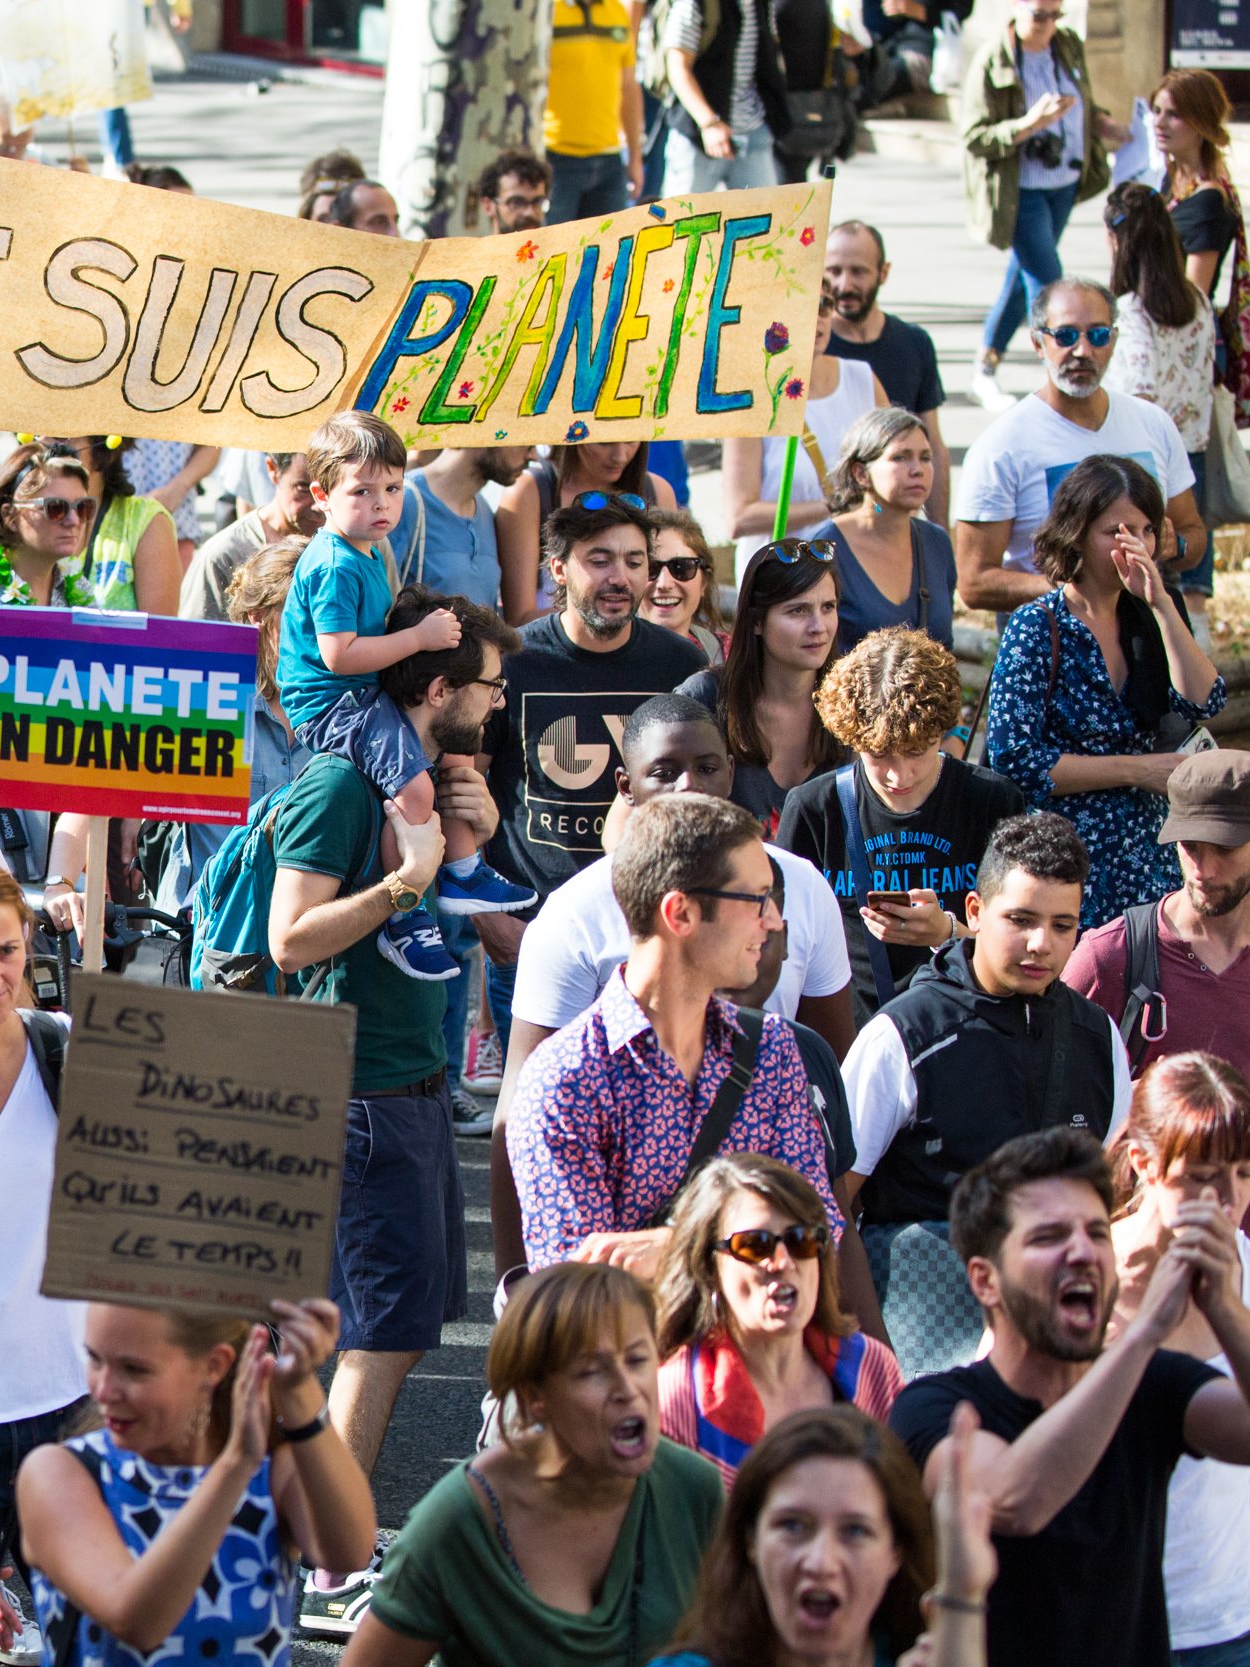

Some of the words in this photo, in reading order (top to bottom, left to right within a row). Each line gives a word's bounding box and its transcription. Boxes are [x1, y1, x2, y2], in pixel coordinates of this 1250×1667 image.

[14, 236, 375, 419] SUIS
[352, 204, 772, 426] PLANÈTE
[44, 715, 236, 778] DANGER
[900, 831, 934, 846] BRAND
[934, 838, 952, 856] LTD.
[82, 996, 165, 1043] LES
[111, 1230, 158, 1260] LE
